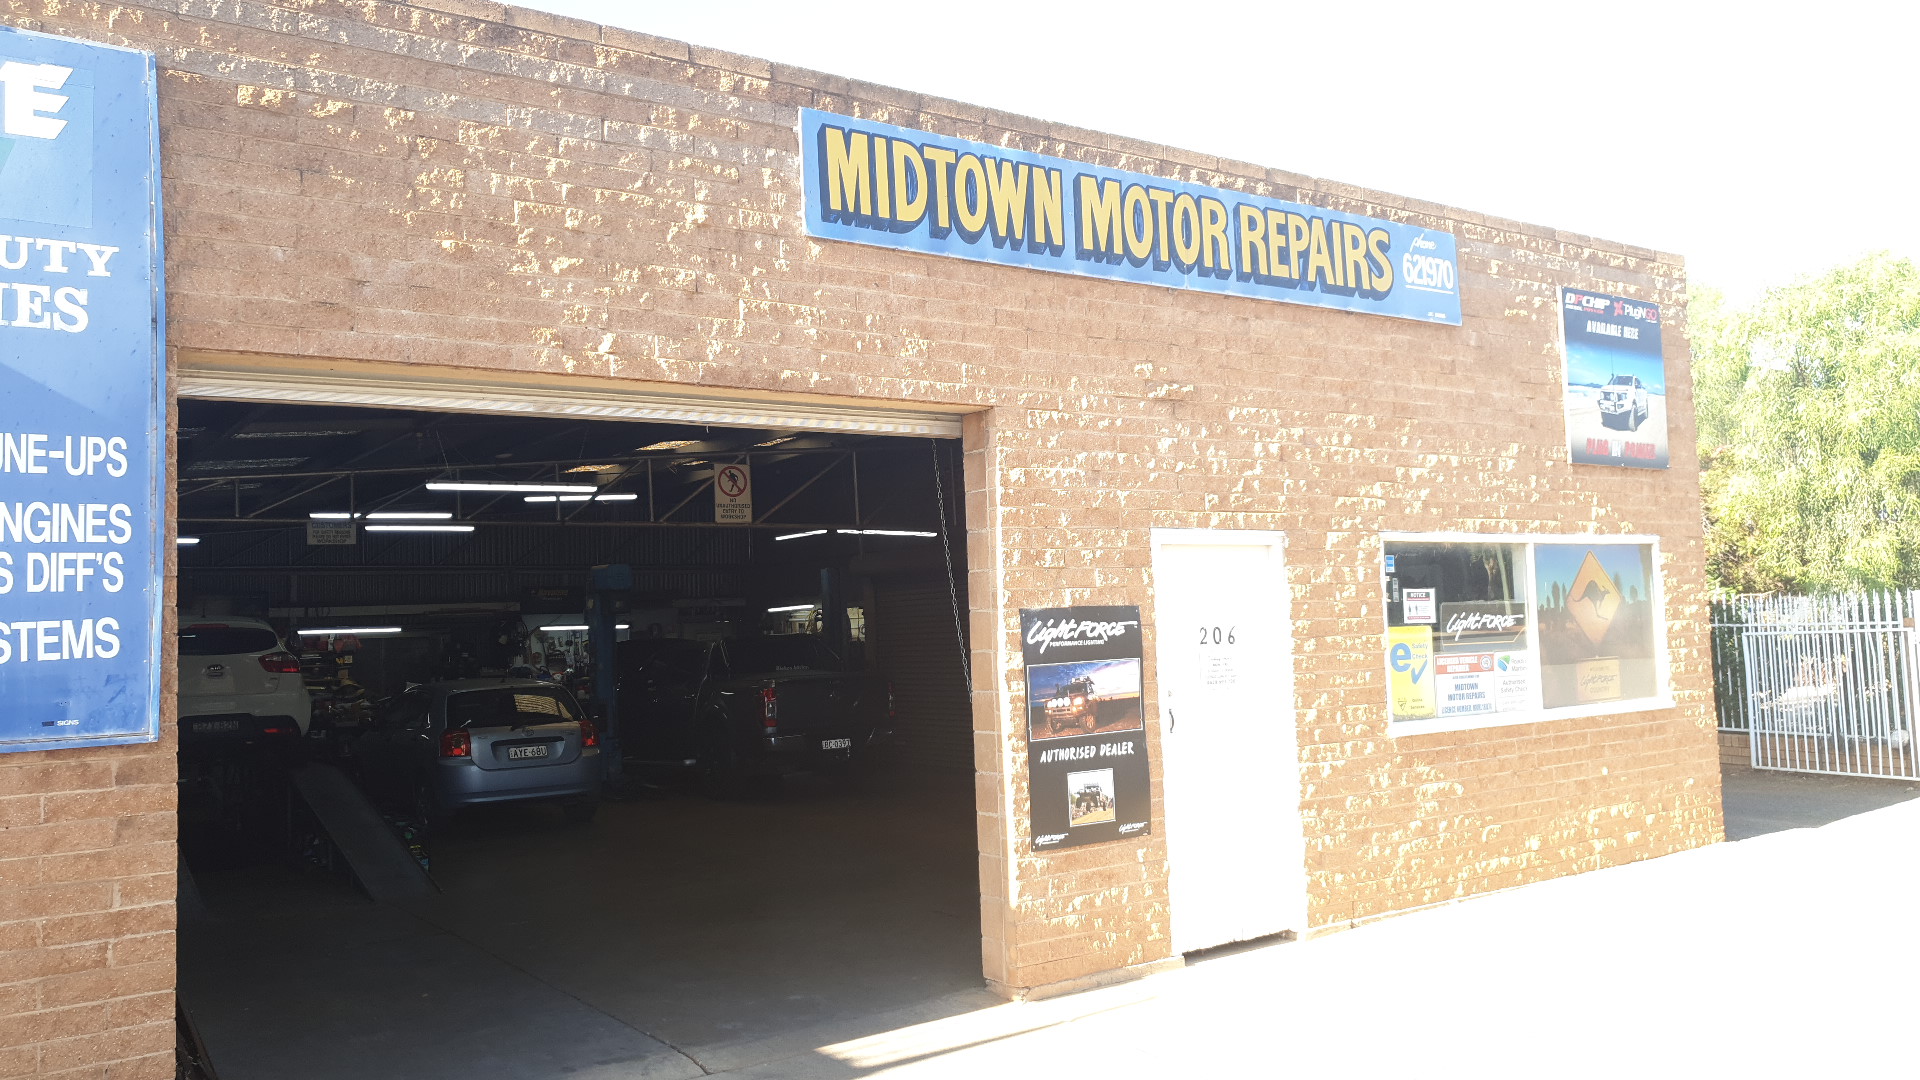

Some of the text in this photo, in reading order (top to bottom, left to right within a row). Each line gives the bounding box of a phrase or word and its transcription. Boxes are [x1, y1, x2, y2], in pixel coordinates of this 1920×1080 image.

[818, 123, 1394, 301] MIDTOWN MOTOR REPAIRS
[1403, 253, 1454, 290] 621970
[1586, 320, 1640, 340] AVAILABLE HERE
[0, 433, 128, 477] NE-UPS
[0, 501, 132, 545] NGINES
[27, 551, 124, 593] DIFF'S
[1049, 640, 1084, 648] PERFORMANCE
[1199, 626, 1236, 645] 206
[1411, 643, 1428, 651] Safety
[1447, 691, 1486, 701] MOTOR REPAIRS
[1454, 682, 1479, 691] MIDTOWN
[56, 719, 80, 727] SIGNS
[1040, 741, 1135, 764] AUTHORISED DEALER
